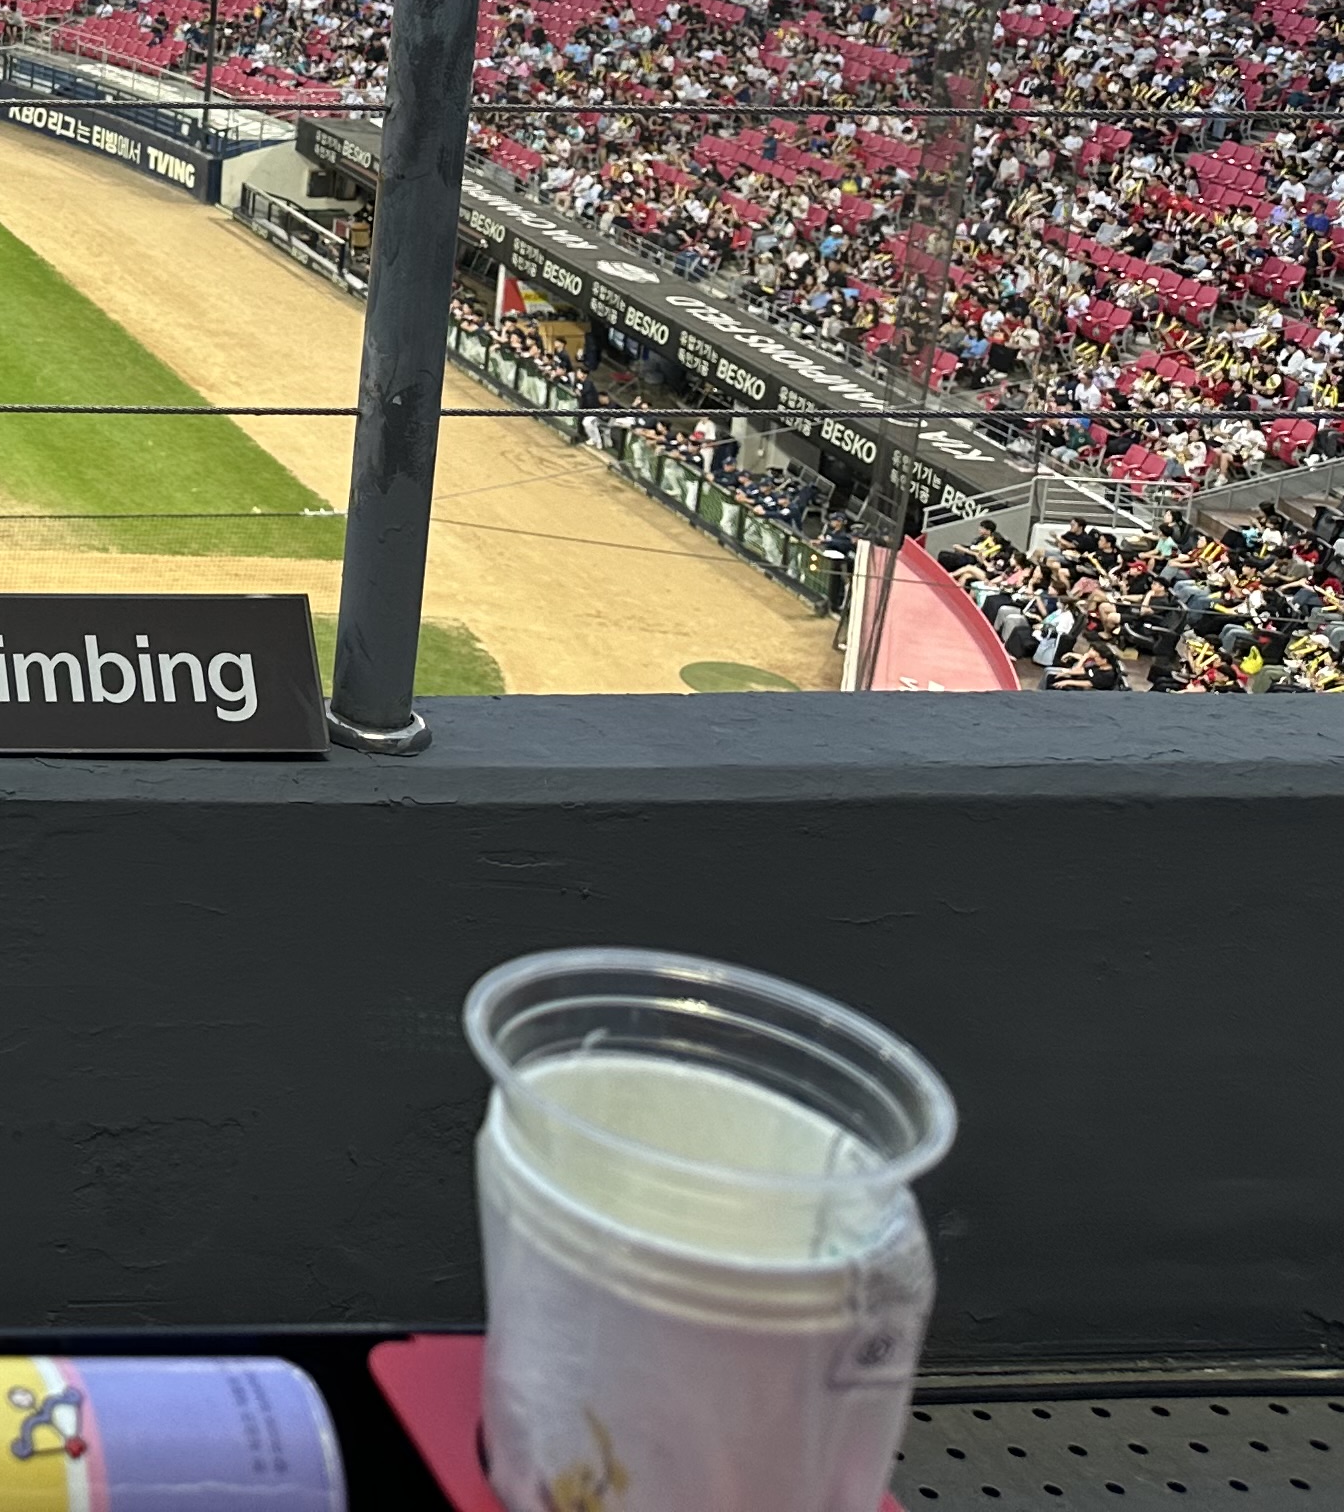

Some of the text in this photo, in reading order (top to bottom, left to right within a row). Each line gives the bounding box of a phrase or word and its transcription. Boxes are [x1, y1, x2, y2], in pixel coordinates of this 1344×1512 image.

[9, 105, 195, 189] KBO 리그는 티빙에서 TVING
[342, 140, 371, 168] BESKO
[470, 209, 506, 244] BESKO
[542, 260, 583, 296] BESKO
[624, 305, 670, 345] BESKO
[716, 358, 766, 401] BESKO
[821, 417, 877, 464] BESKO
[941, 483, 989, 521] BESK
